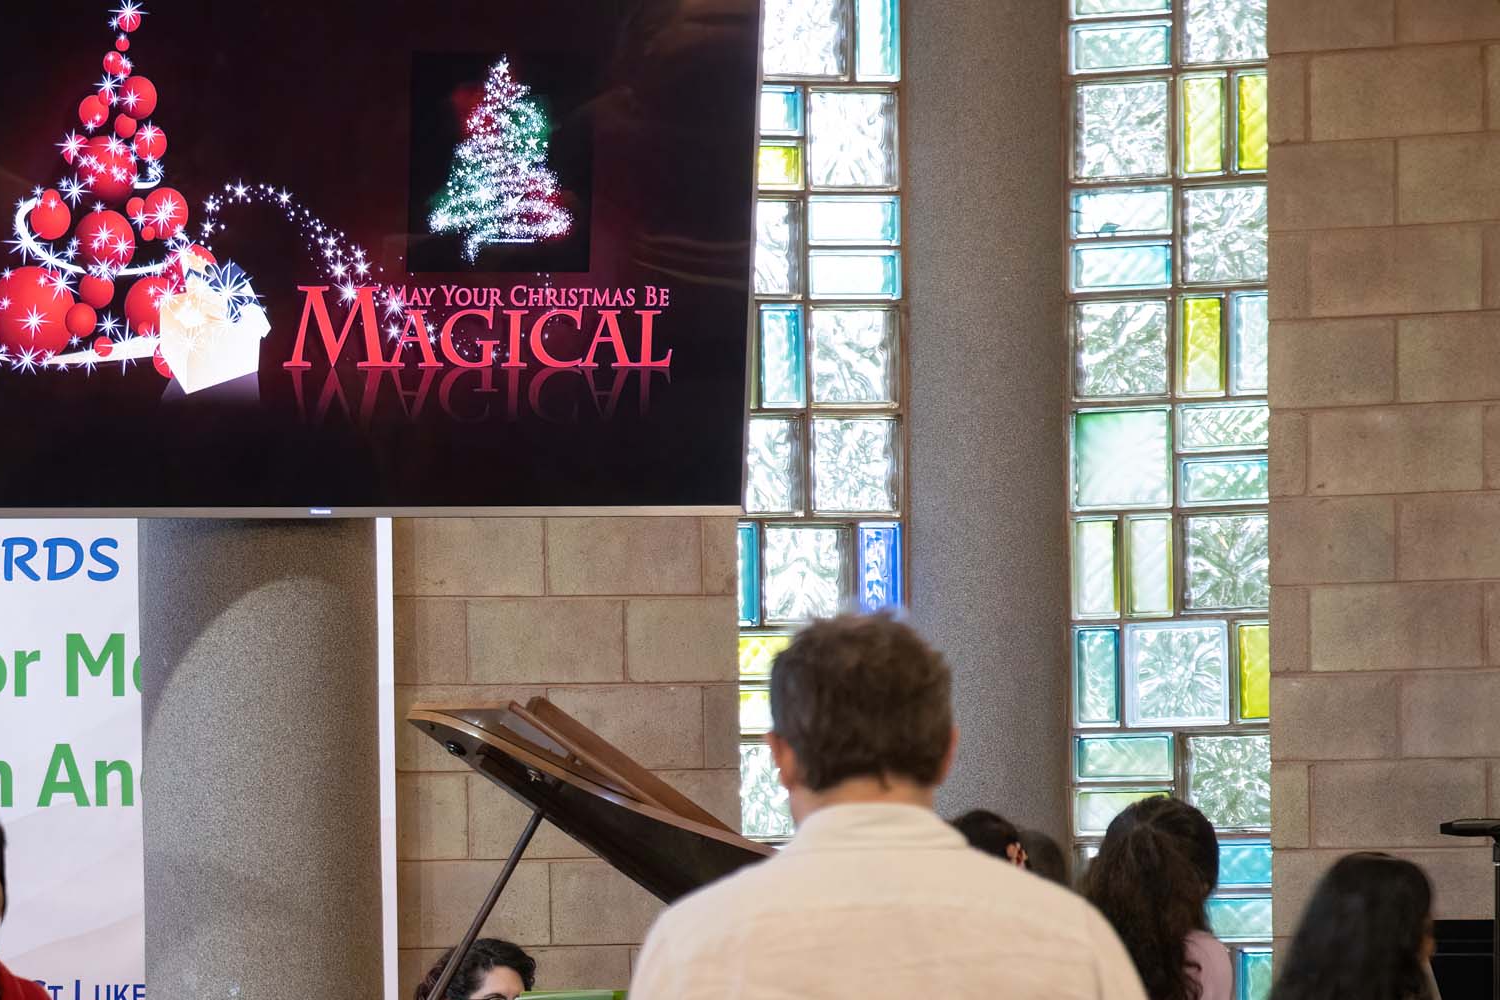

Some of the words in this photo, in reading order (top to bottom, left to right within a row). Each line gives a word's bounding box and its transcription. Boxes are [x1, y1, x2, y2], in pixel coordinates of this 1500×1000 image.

[283, 285, 673, 368] MAGICAL
[386, 285, 435, 307] MAY
[440, 285, 504, 307] YOUR
[509, 284, 636, 307] CHRISTMAS
[644, 286, 670, 307] BE
[65, 633, 143, 697] M
[36, 743, 143, 807] An
